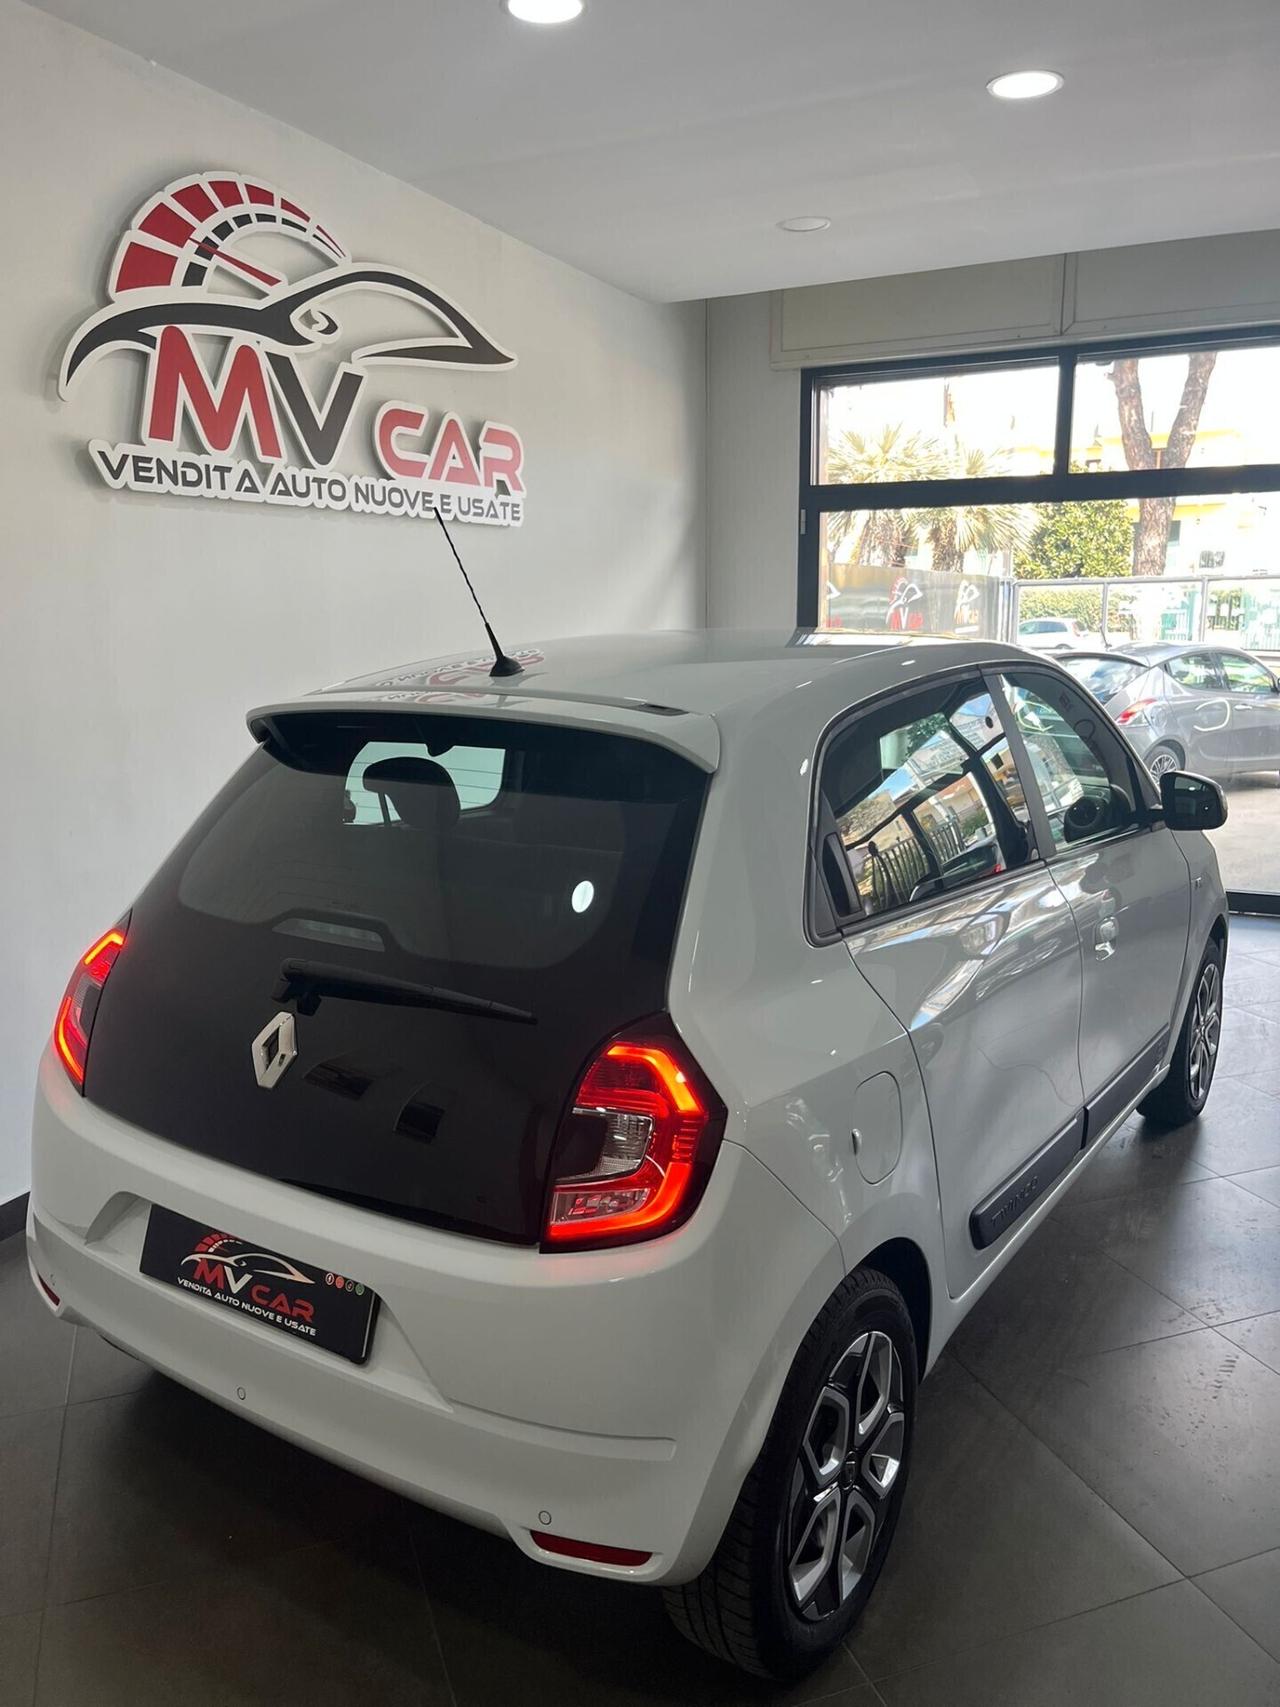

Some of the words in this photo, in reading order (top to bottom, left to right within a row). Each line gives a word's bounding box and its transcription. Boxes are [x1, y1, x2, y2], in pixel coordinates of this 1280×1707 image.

[148, 325, 364, 466] MV
[377, 407, 523, 491] CAR
[97, 450, 260, 494] VENDITA
[269, 471, 347, 501] AUTO
[354, 482, 434, 512] NUOVE
[440, 493, 452, 514] E
[458, 495, 521, 522] USATE
[177, 1276, 212, 1297] VENDITA
[214, 1292, 240, 1307] AUTO
[241, 1302, 275, 1321] NUOVE
[276, 1314, 283, 1324] E
[284, 1318, 317, 1336] USATE
[193, 1258, 253, 1294] MV
[251, 1284, 315, 1323] CAR
